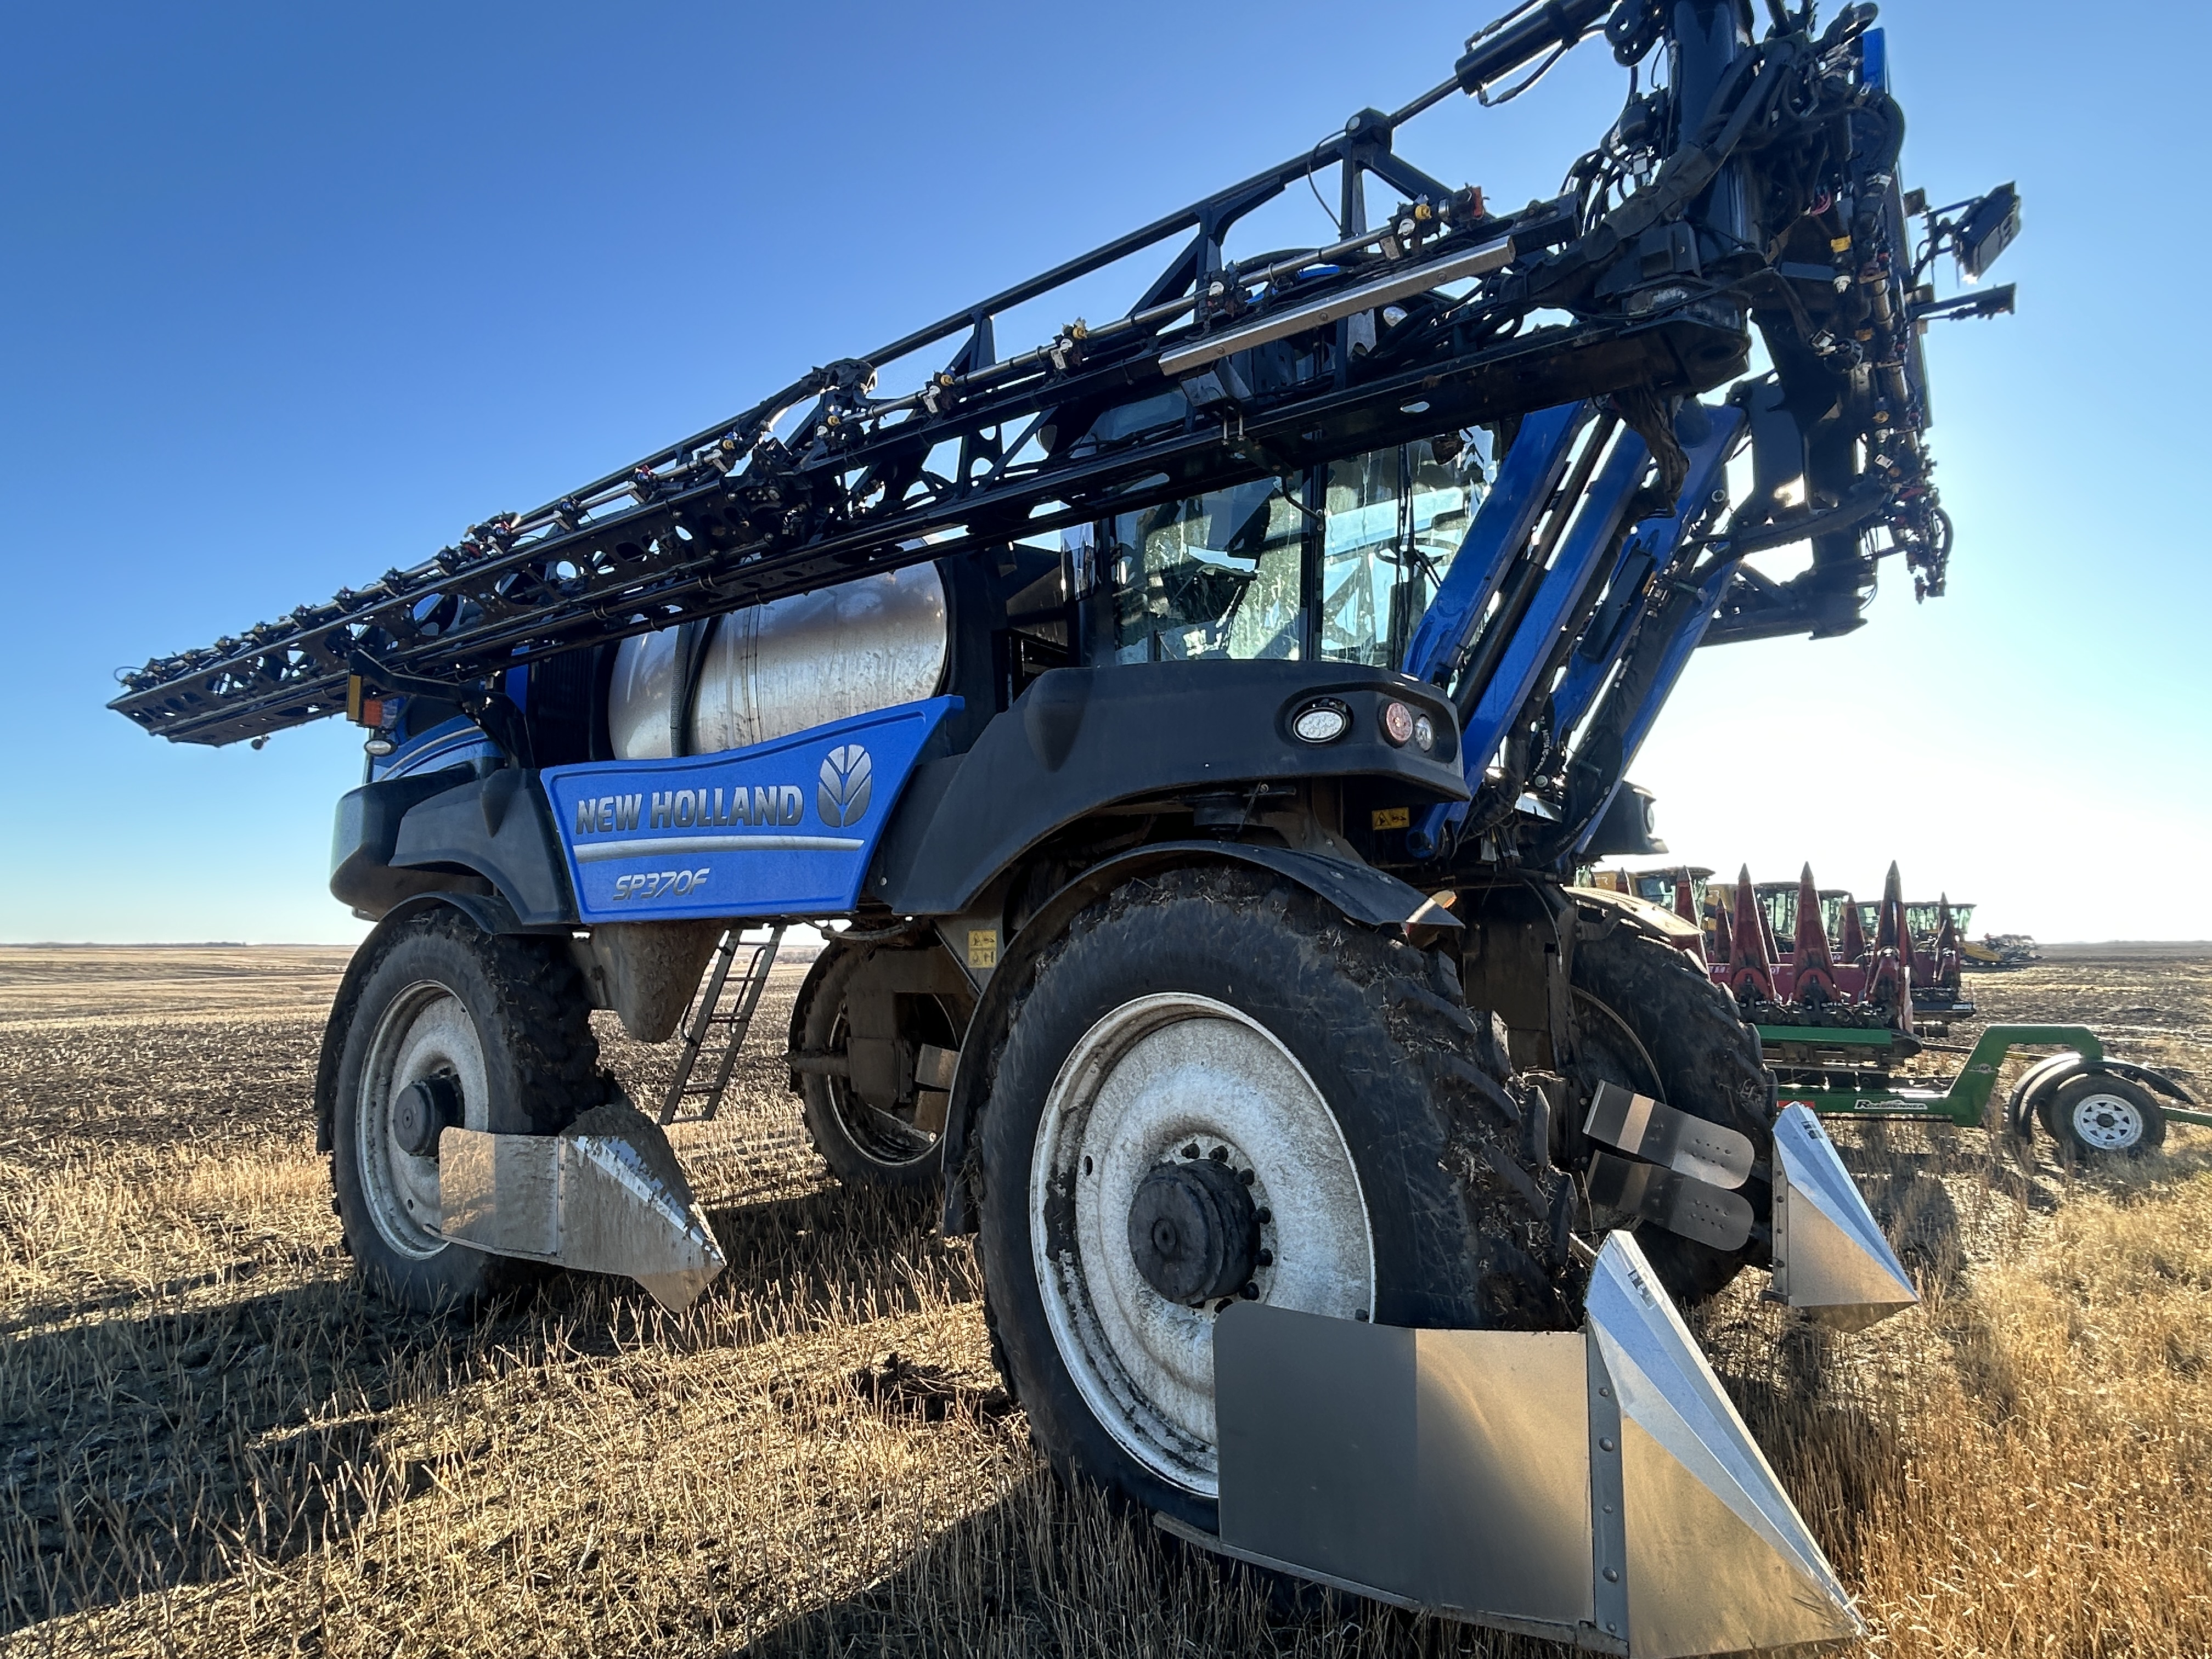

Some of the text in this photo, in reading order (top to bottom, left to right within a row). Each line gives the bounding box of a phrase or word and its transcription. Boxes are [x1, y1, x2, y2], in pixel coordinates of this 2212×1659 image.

[575, 786, 804, 834] NEW HOLLAND
[613, 868, 710, 900] SP370F
